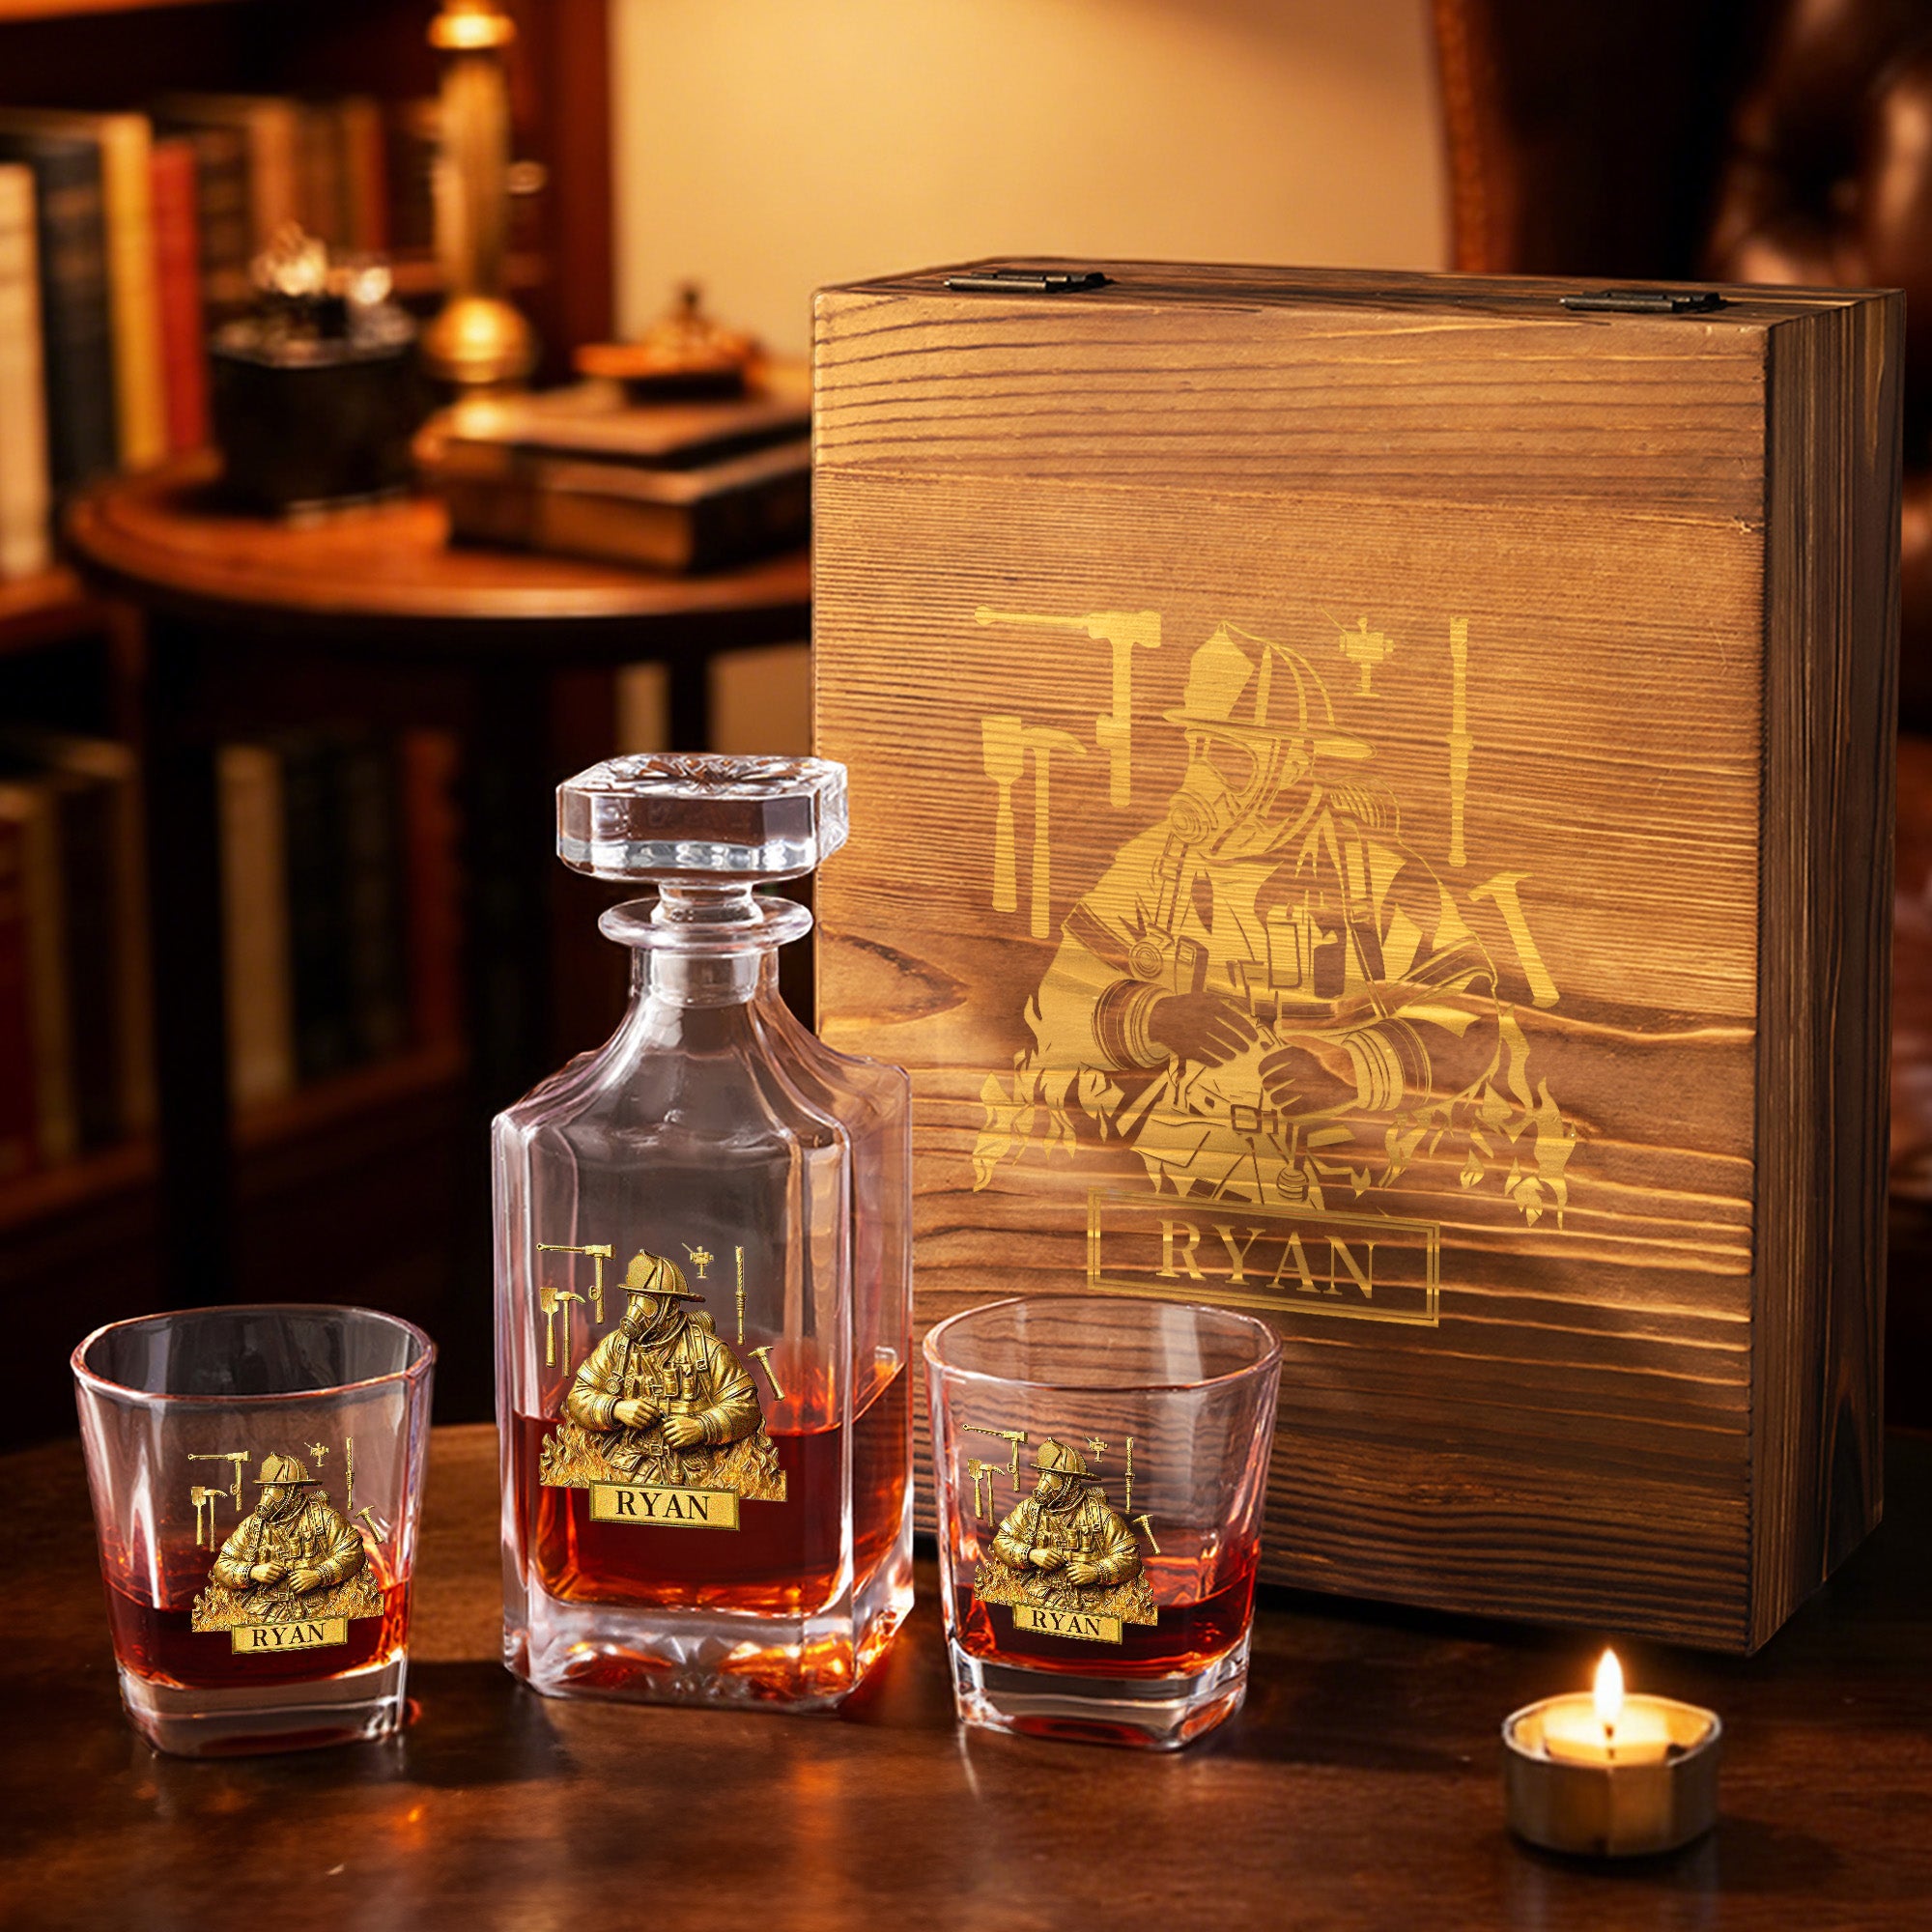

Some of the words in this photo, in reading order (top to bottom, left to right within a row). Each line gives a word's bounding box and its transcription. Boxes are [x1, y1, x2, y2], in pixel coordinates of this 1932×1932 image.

[1156, 1218, 1379, 1299] RYAN
[615, 1490, 710, 1520] RYAN
[252, 1623, 326, 1647] RYAN
[1031, 1609, 1101, 1635] RYAN
